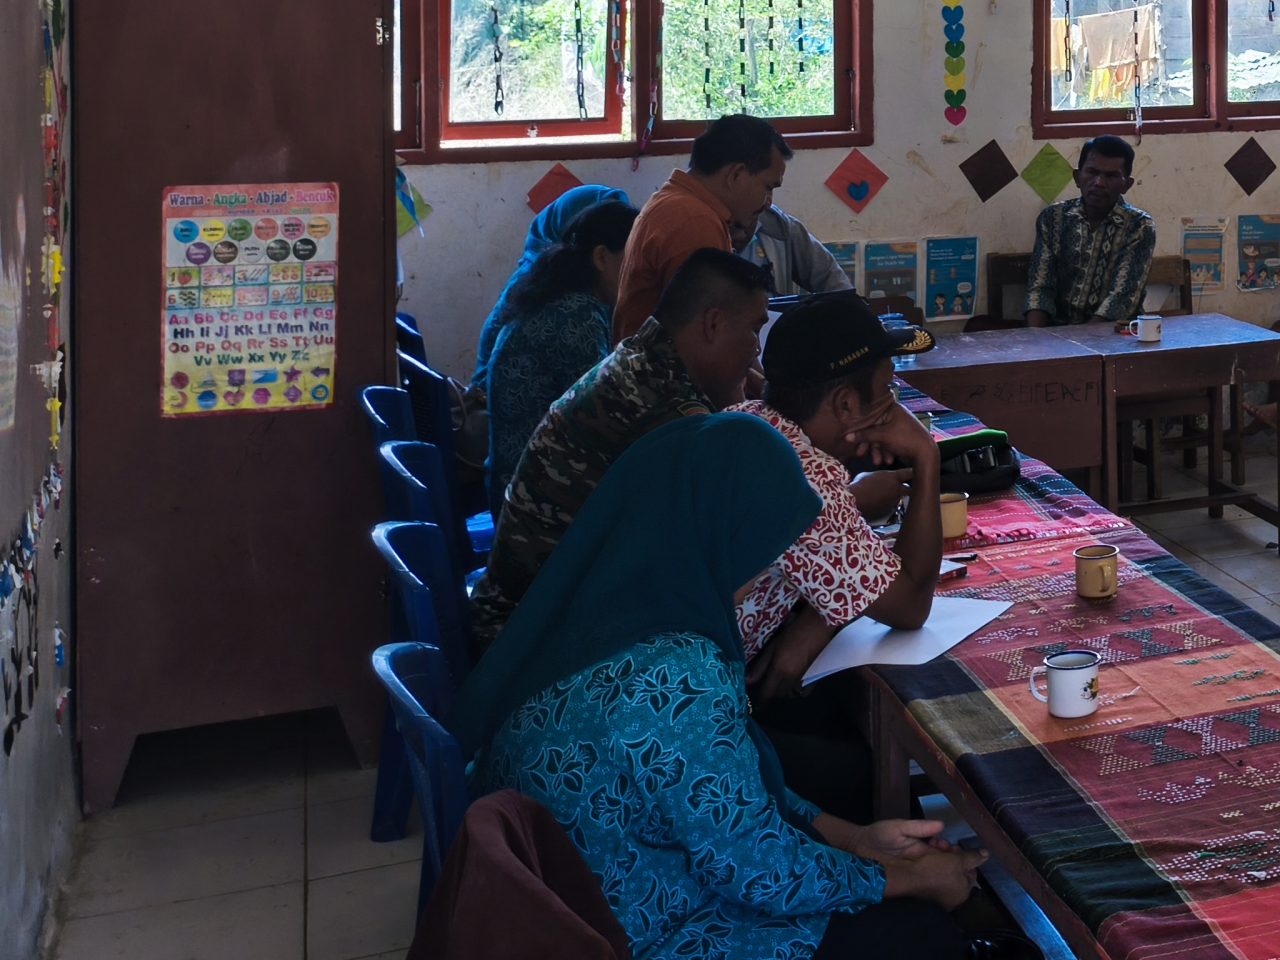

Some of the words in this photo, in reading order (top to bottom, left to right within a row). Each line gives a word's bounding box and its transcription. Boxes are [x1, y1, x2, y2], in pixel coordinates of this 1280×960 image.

[170, 193, 204, 206] Warna
[213, 193, 247, 207] Angka
[256, 191, 287, 205] Abjad
[296, 190, 334, 203] Bentuk
[170, 271, 175, 282] 1
[168, 294, 176, 305] 6
[272, 290, 280, 300] 9
[306, 288, 317, 299] 10
[169, 314, 188, 325] Aa
[195, 313, 213, 323] Bb
[220, 312, 239, 322] Cc
[244, 310, 263, 321] Dd
[270, 311, 287, 320] Ee
[294, 308, 308, 319] Ff
[313, 308, 333, 320] Gg
[173, 328, 194, 338] Hh
[200, 327, 209, 337] Ii
[215, 326, 228, 338] Jj
[235, 325, 253, 335] Kk
[277, 323, 303, 333] Mm
[310, 322, 329, 332] Nn
[169, 343, 189, 353] Oo
[195, 342, 215, 353] Pp
[221, 340, 242, 352] Qq
[248, 339, 264, 349] Rr
[270, 338, 287, 348] Ss
[293, 336, 309, 346] Tt
[314, 335, 333, 345] Uu
[194, 356, 212, 366] Vv
[218, 355, 243, 364] Ww
[248, 353, 264, 362] Xx
[269, 352, 286, 362] Yy
[292, 351, 310, 360] Zz
